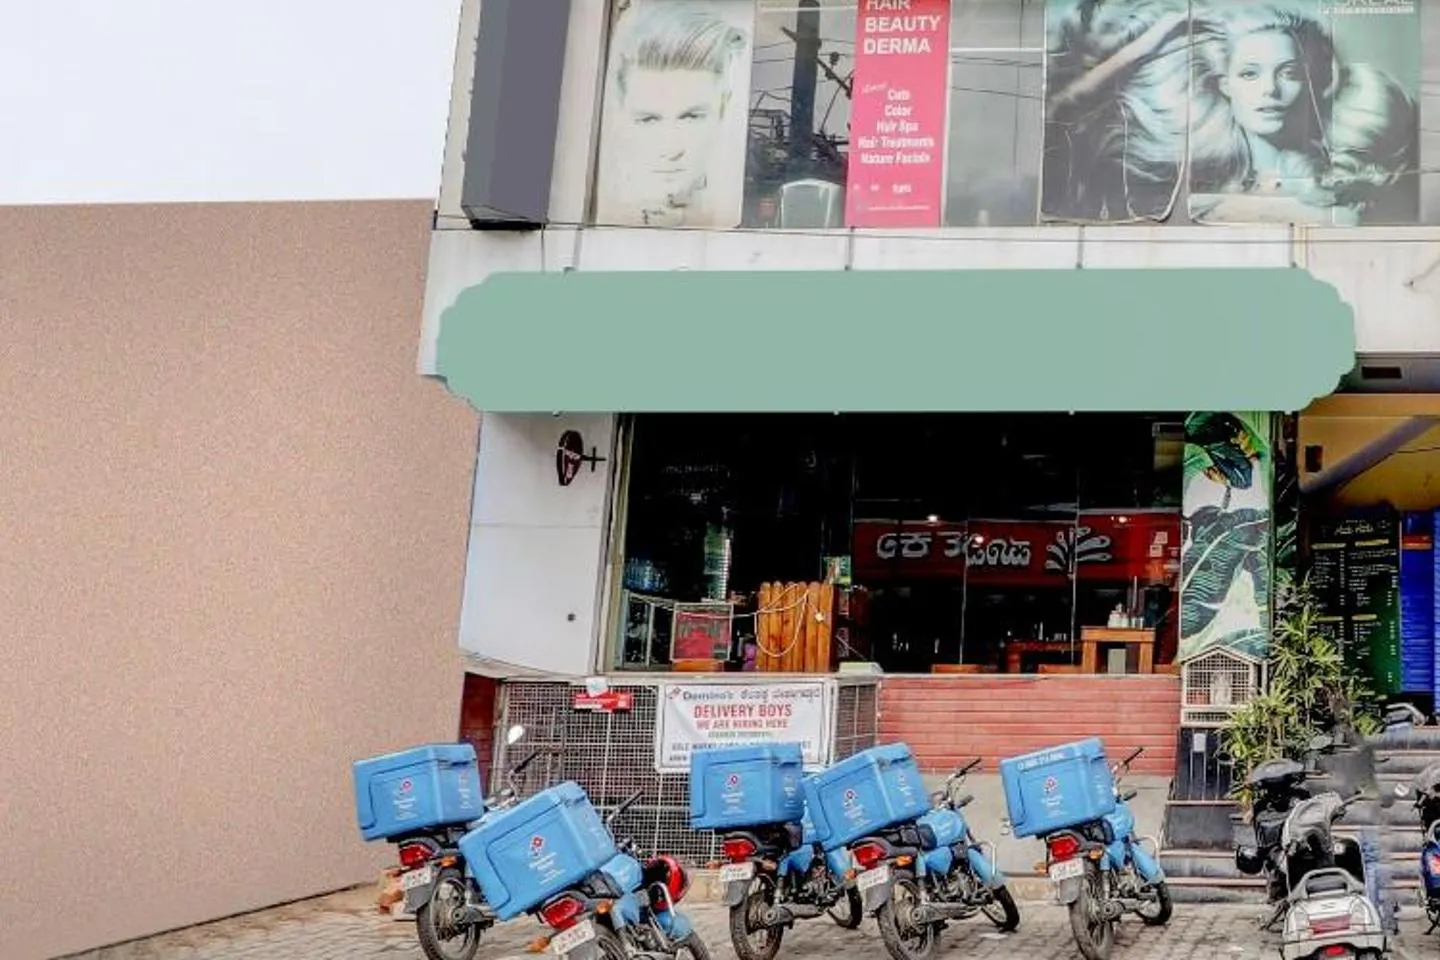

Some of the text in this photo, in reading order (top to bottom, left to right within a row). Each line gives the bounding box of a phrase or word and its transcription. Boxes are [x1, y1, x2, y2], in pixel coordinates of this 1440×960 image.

[864, 15, 942, 33] BEAUTY
[863, 38, 931, 55] DERMA
[682, 690, 735, 701] Domino's
[693, 703, 793, 719] DELIVERY BOYS
[696, 718, 788, 730] WE ARE HIRING HERE
